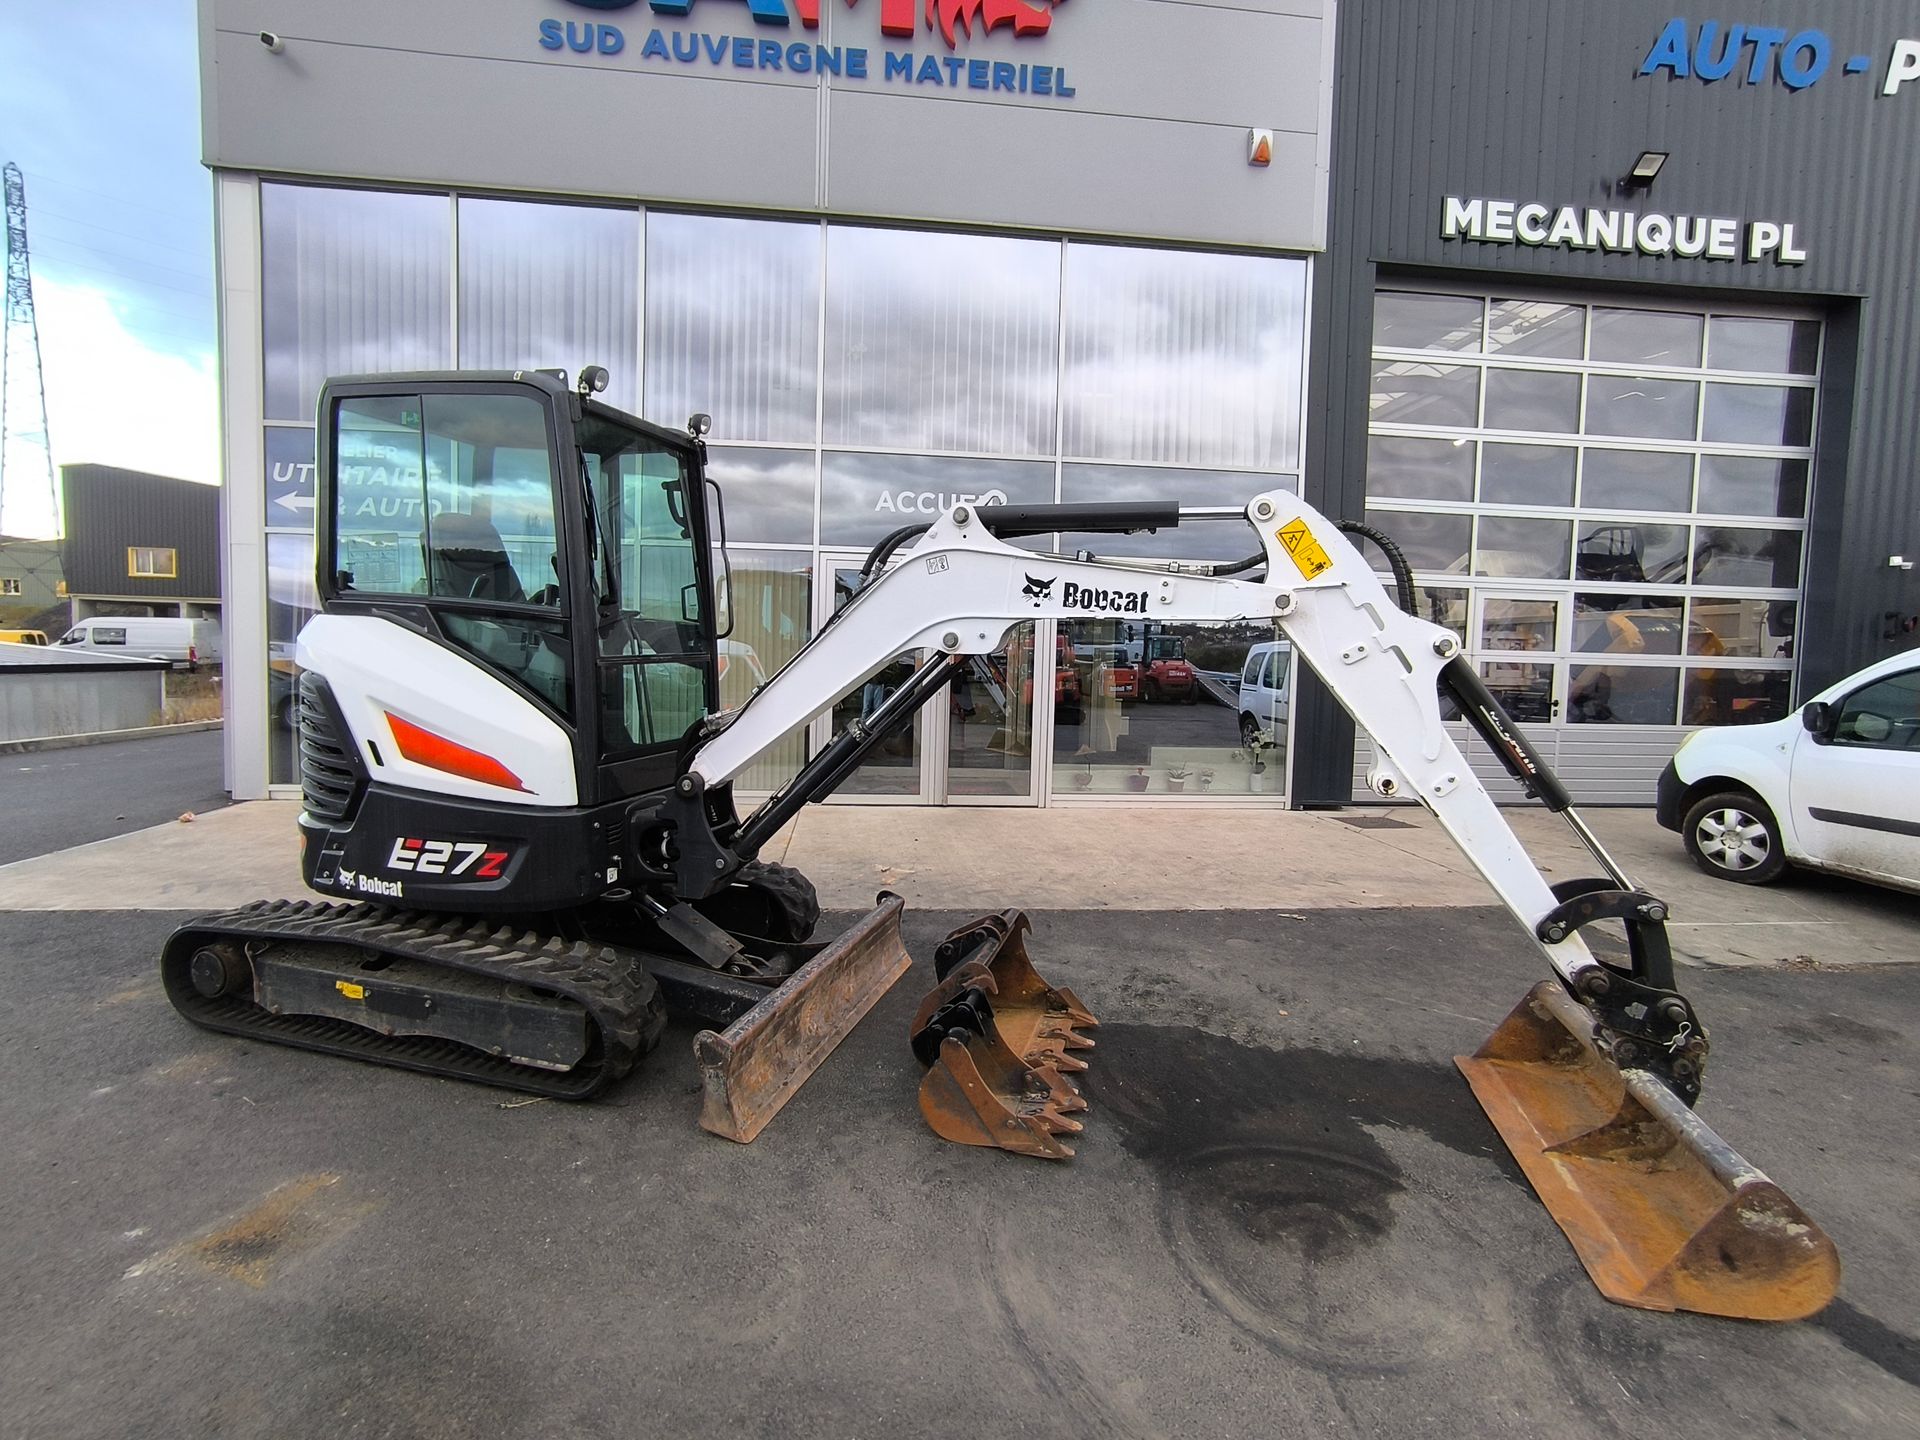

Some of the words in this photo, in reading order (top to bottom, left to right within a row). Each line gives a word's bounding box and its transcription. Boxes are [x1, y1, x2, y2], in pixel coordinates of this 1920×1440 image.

[539, 18, 625, 54] SUD
[640, 28, 868, 78] AUVERGNE
[885, 51, 1076, 97] MATERIEL
[1638, 17, 1832, 88] AUTO
[1443, 196, 1738, 257] MECANIQUE
[1750, 221, 1807, 262] PL
[355, 497, 443, 518] AUTO
[1063, 582, 1149, 613] Bobcat
[359, 874, 403, 897] Bobcat
